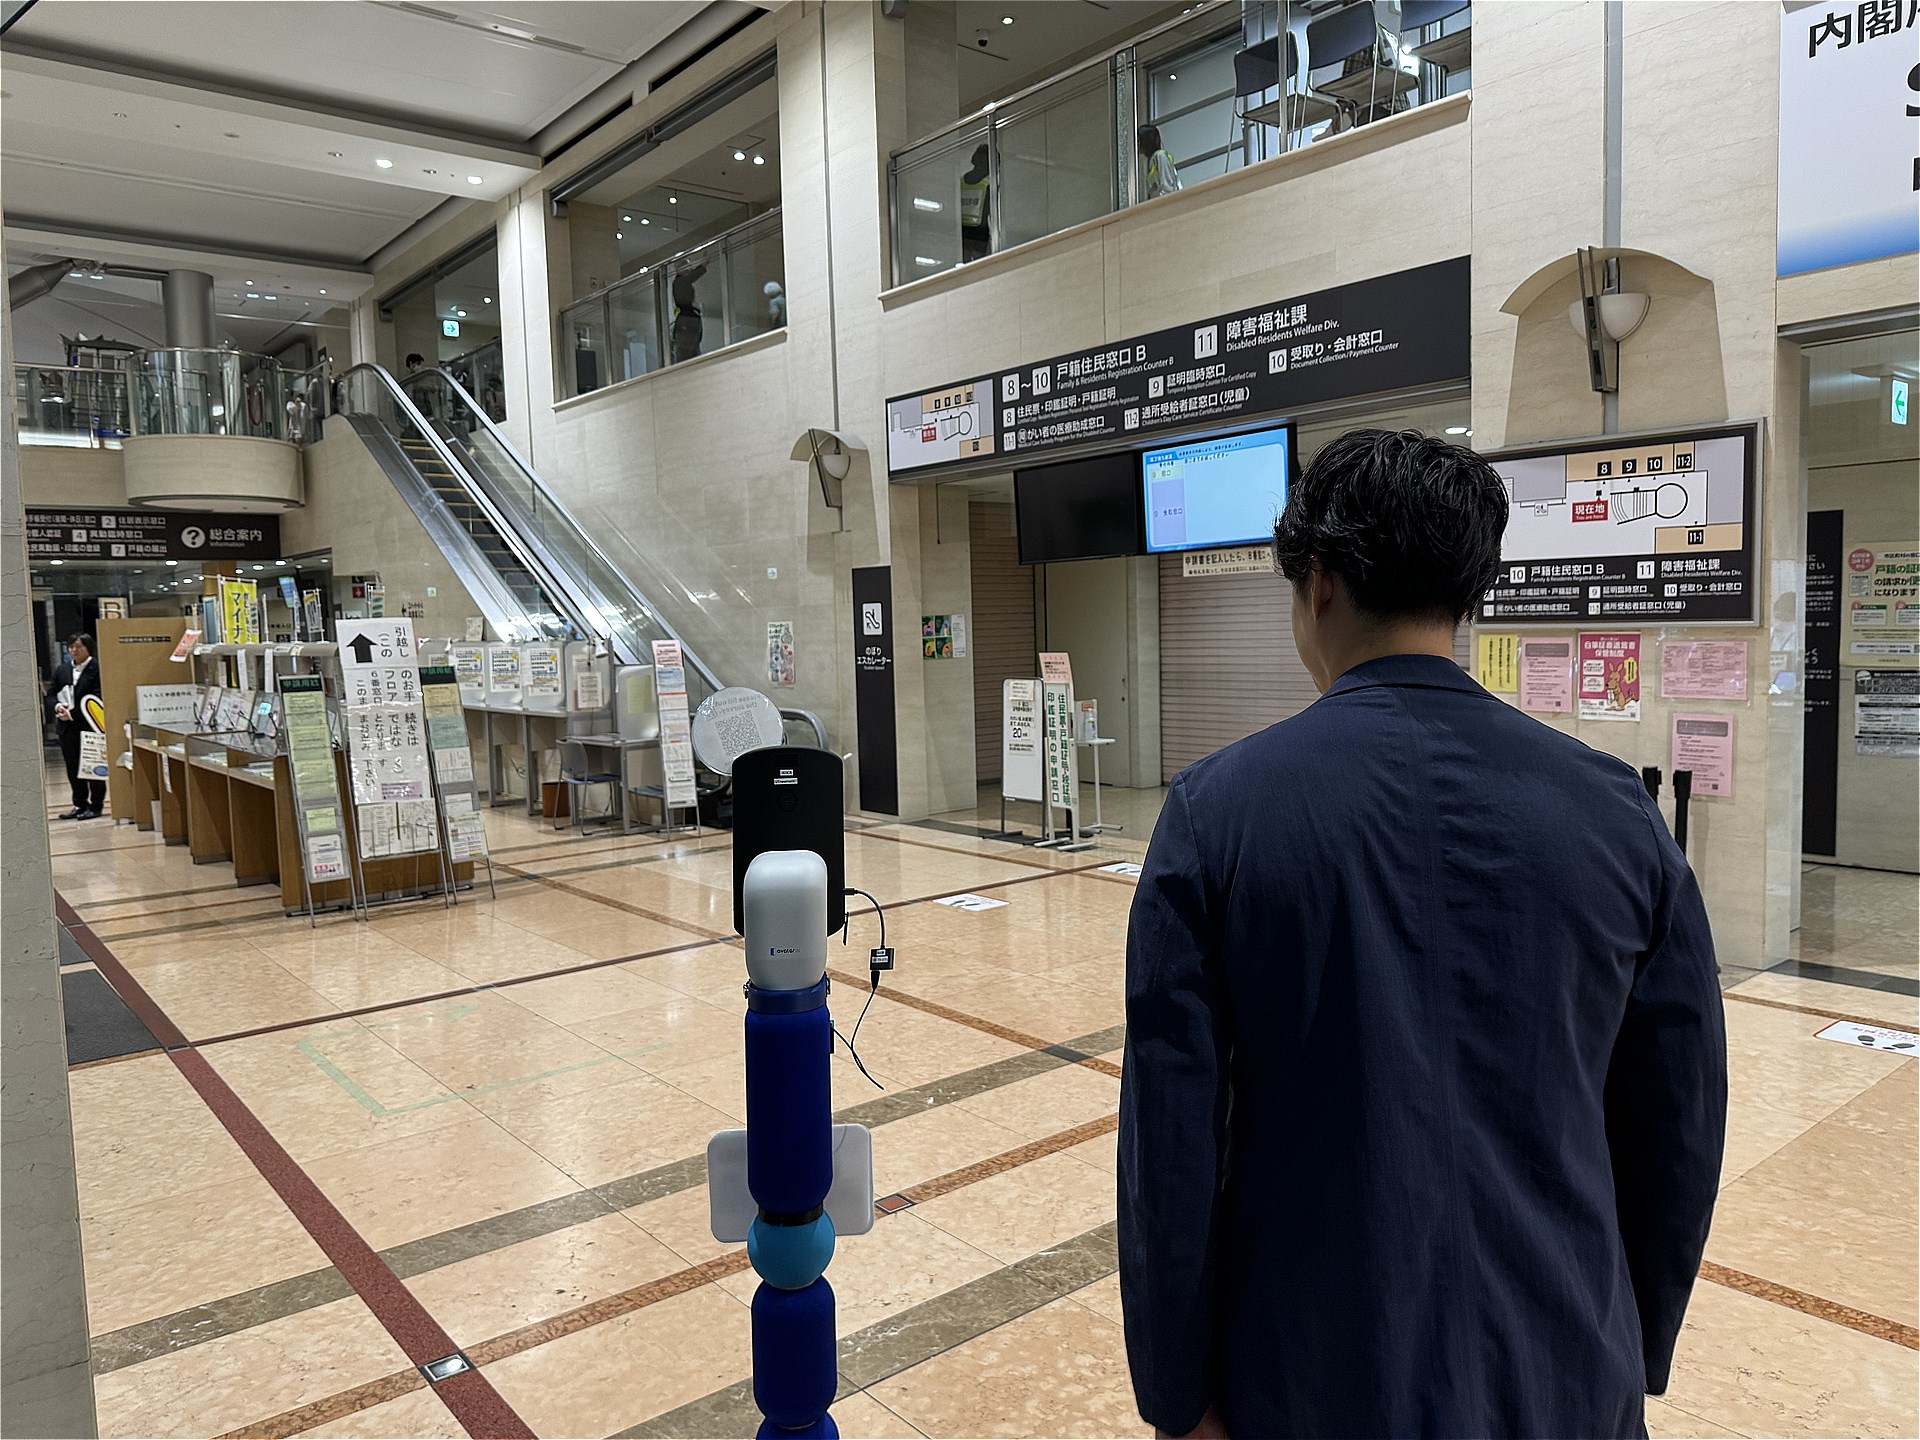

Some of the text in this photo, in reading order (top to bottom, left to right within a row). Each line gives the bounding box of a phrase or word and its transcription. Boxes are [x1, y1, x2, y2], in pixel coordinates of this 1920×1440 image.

[1808, 0, 1919, 58] 内閣
[1198, 304, 1308, 352] 11 障害福祉課
[1226, 319, 1340, 352] Disabled Residents Welfare Div.
[1270, 329, 1383, 369] 10 受取り・会計窓口
[1375, 342, 1400, 355] Counter
[1056, 348, 1132, 381] 戸籍住民窓口
[1136, 345, 1147, 362] B
[1143, 359, 1168, 371] Counter
[1575, 504, 1605, 515] 現在地
[209, 528, 263, 542] 総合案内
[1530, 564, 1592, 577] 戸籍住民窓口
[1595, 563, 1605, 575] B
[1661, 558, 1721, 572] 障害福祉課
[231, 592, 243, 643] マイナ
[865, 647, 882, 655] のぼり
[857, 656, 892, 665] エスカレーター
[1012, 727, 1022, 738] 20
[1047, 692, 1060, 803] 印鑑証明の申請窓口
